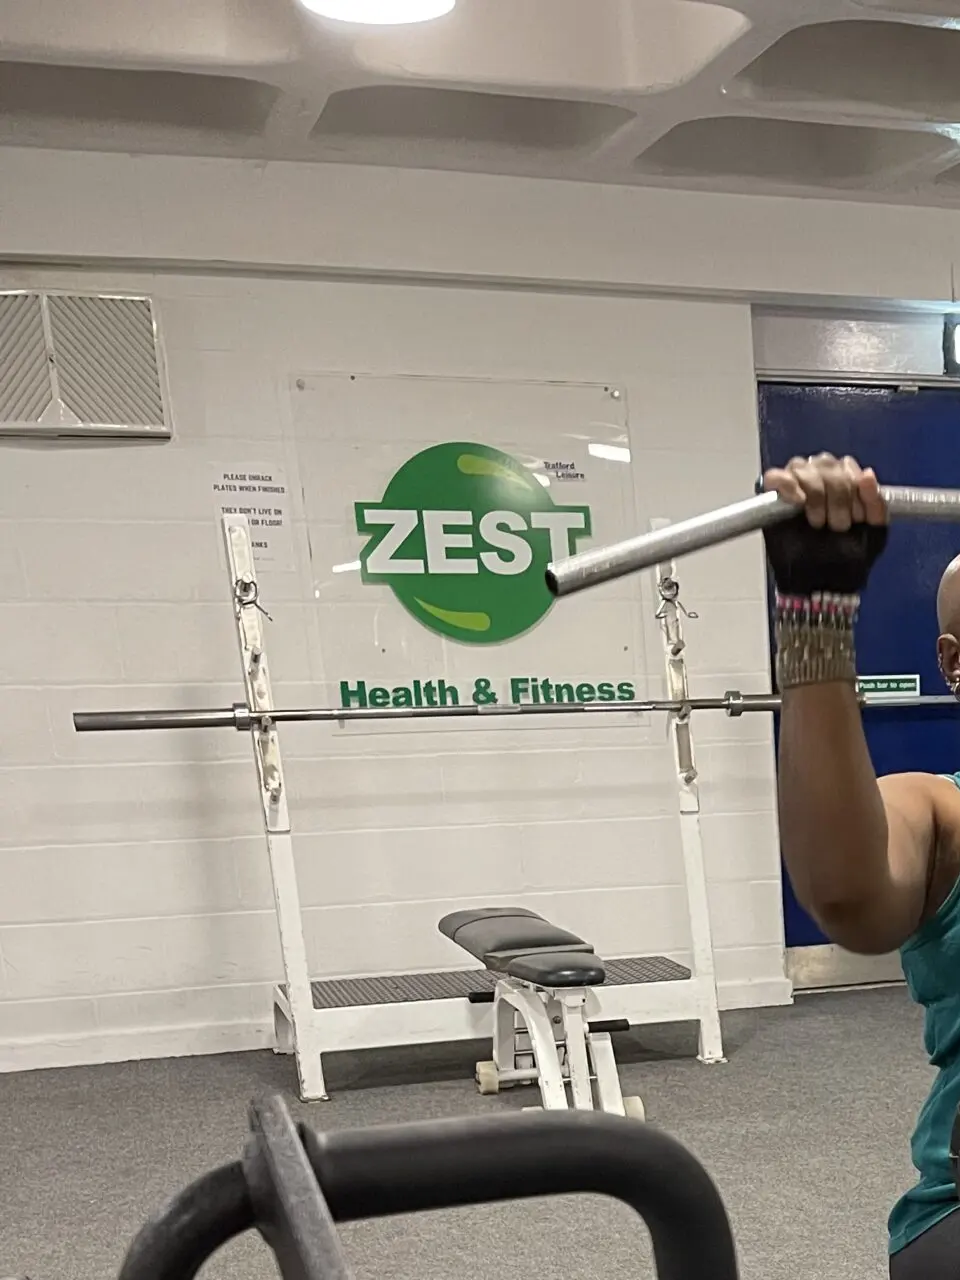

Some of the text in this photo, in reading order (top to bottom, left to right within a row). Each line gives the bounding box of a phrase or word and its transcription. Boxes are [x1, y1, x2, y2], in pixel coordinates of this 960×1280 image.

[221, 506, 237, 514] THEY
[258, 508, 272, 516] LIVE
[363, 508, 585, 575] ZEST
[340, 677, 636, 708] Health & Fitness
